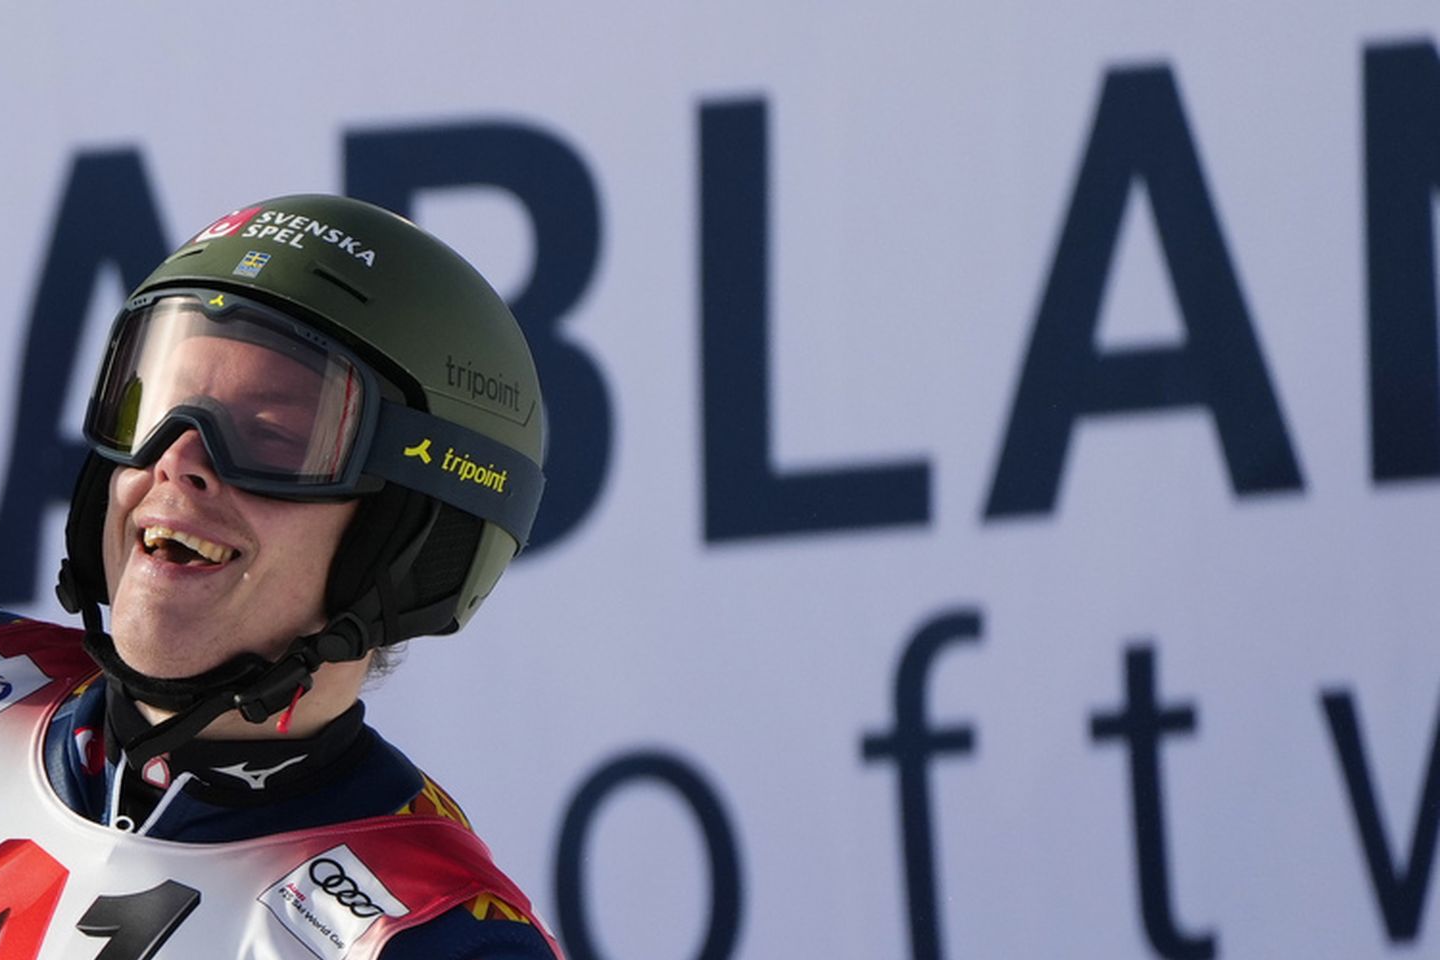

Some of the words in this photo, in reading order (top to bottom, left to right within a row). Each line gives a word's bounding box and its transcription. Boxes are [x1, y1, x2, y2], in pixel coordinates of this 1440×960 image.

[242, 223, 304, 249] SPEL
[256, 210, 377, 267] SVENSKA
[445, 354, 521, 412] tripoint
[441, 448, 508, 493] tripoint
[291, 899, 307, 915] Ski
[304, 911, 331, 936] World
[329, 932, 345, 950] Cup
